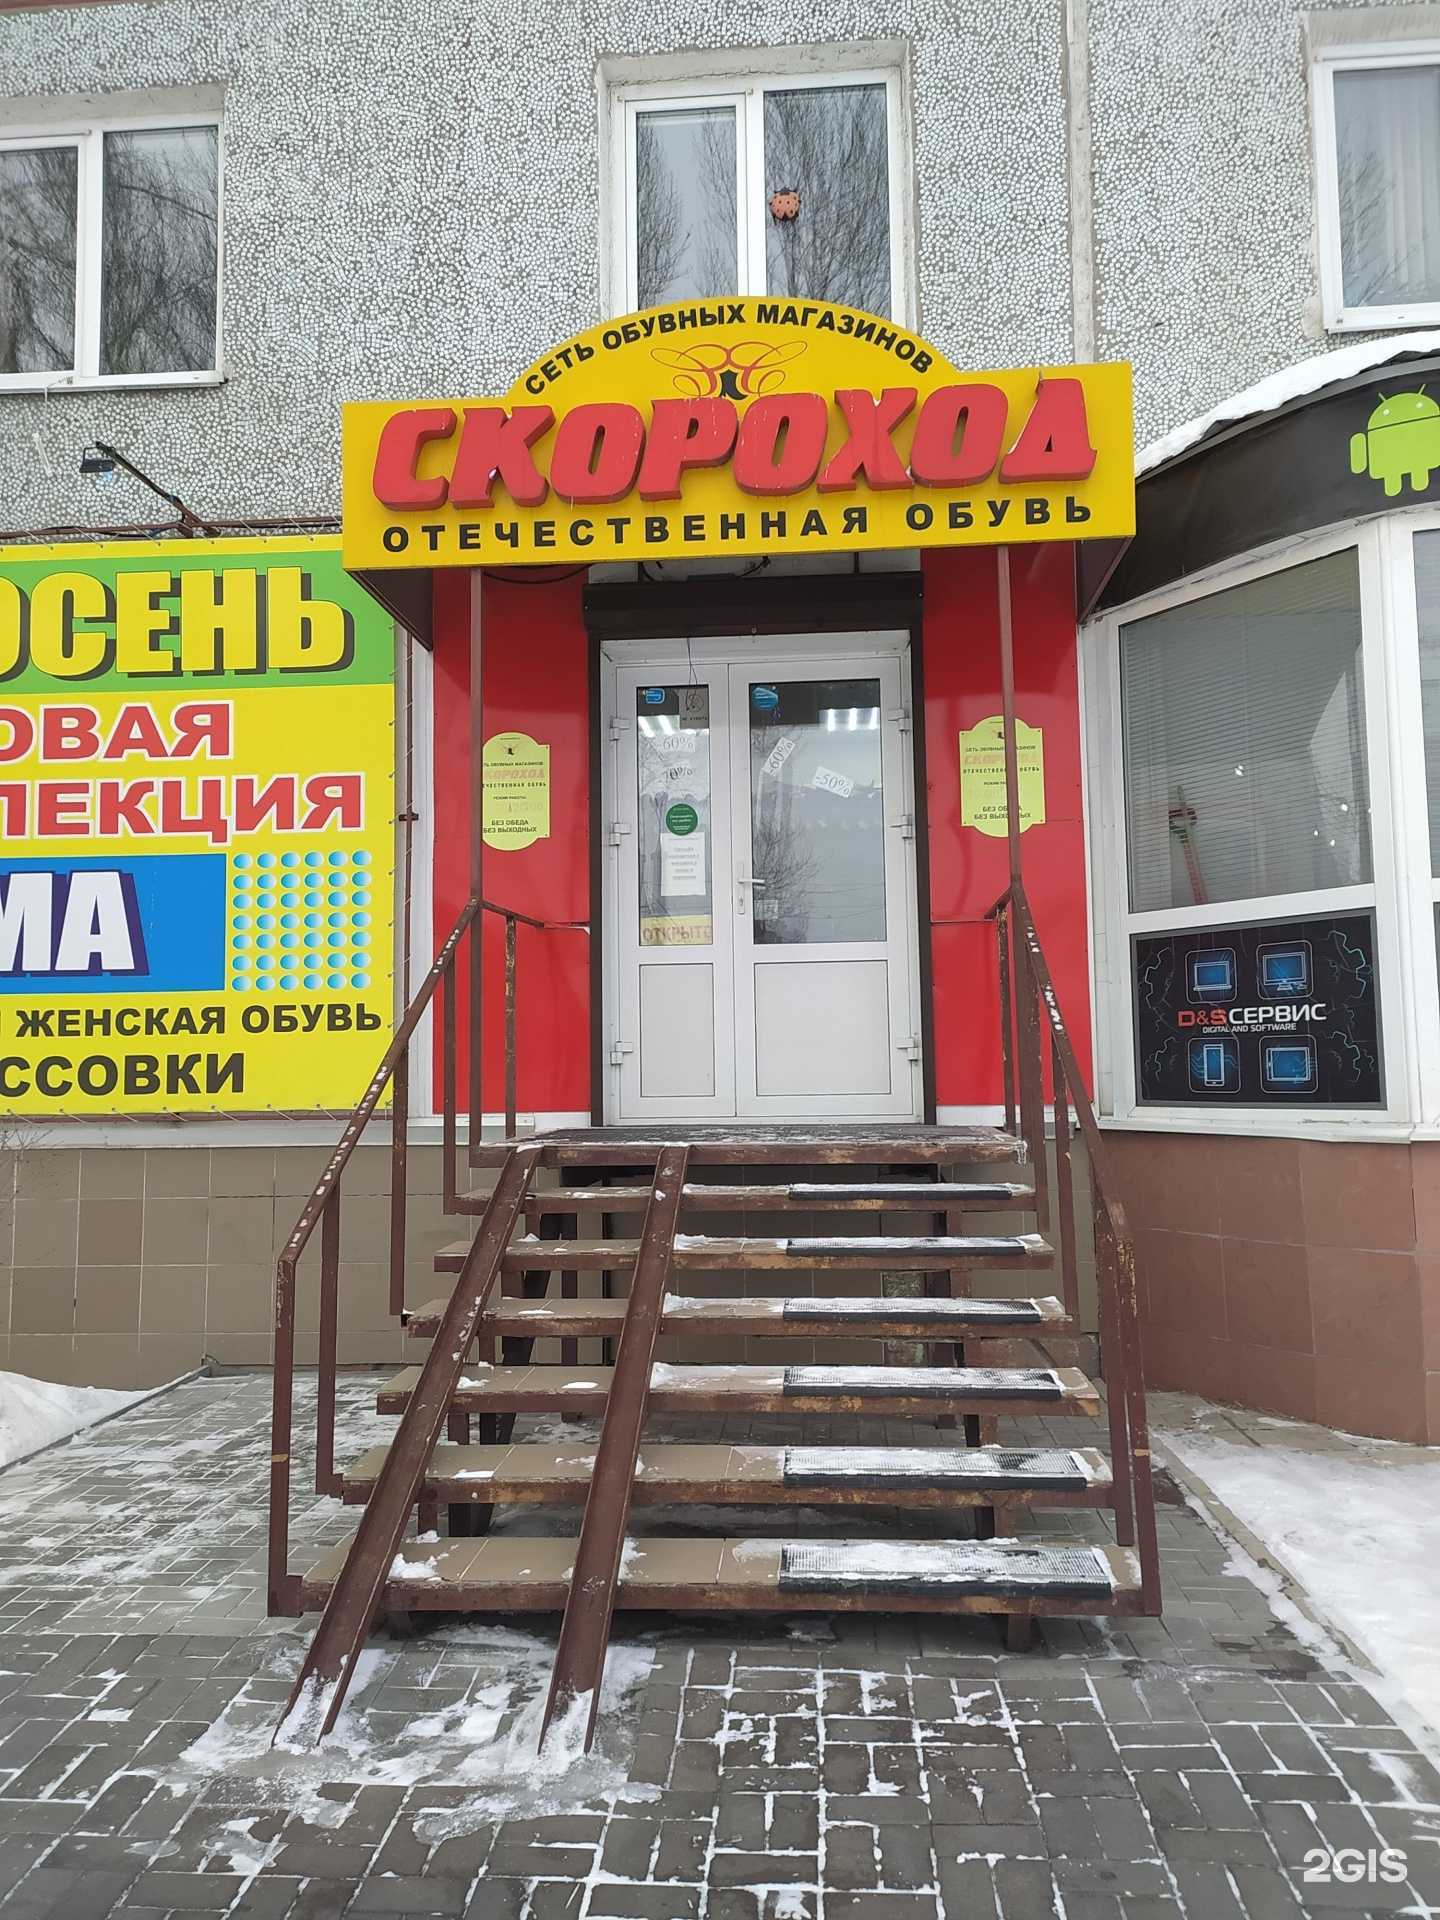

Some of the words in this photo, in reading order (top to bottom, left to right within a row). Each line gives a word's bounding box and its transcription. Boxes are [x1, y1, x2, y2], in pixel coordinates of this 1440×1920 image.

[525, 340, 595, 396] СЕТЬ
[601, 304, 746, 351] ОБУВНЫХ
[756, 303, 934, 375] МАГАЗИНОВ
[372, 378, 1098, 513] СКОРОХОД
[382, 507, 869, 553] ОТЕЧЕСТВЕННАЯ
[905, 496, 1092, 532] ОБУВЬ
[0, 566, 354, 682] СЕНЬ
[769, 742, 794, 776] -60%
[815, 774, 850, 796] -50%
[15, 1007, 227, 1038] ЖЕНСКАЯ
[241, 1003, 382, 1034] ОБУВЬ
[1202, 1024, 1231, 1034] DIGITAL
[1231, 1024, 1249, 1033] AND
[1249, 1022, 1297, 1033] SOFTWARE
[0, 1053, 245, 1098] ССОВКИ
